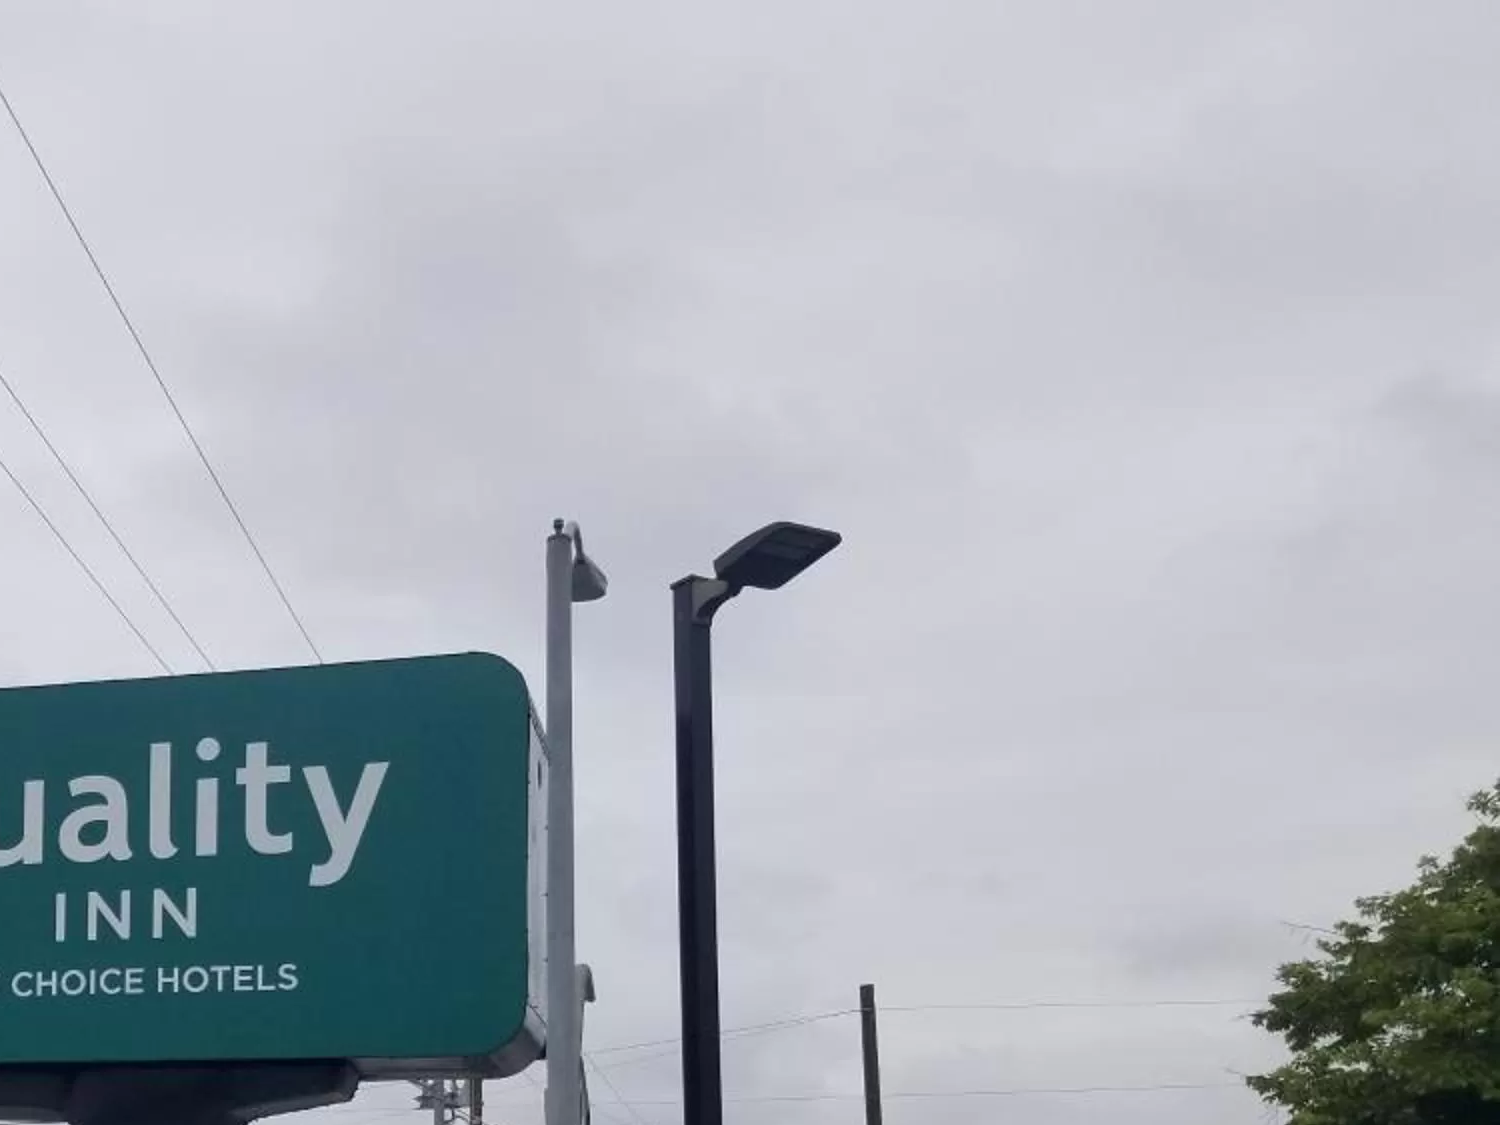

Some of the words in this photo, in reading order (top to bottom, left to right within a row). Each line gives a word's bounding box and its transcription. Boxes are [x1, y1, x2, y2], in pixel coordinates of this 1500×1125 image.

[55, 887, 198, 943] INN
[11, 967, 146, 998] CHOICE
[156, 963, 300, 995] HOTELS
